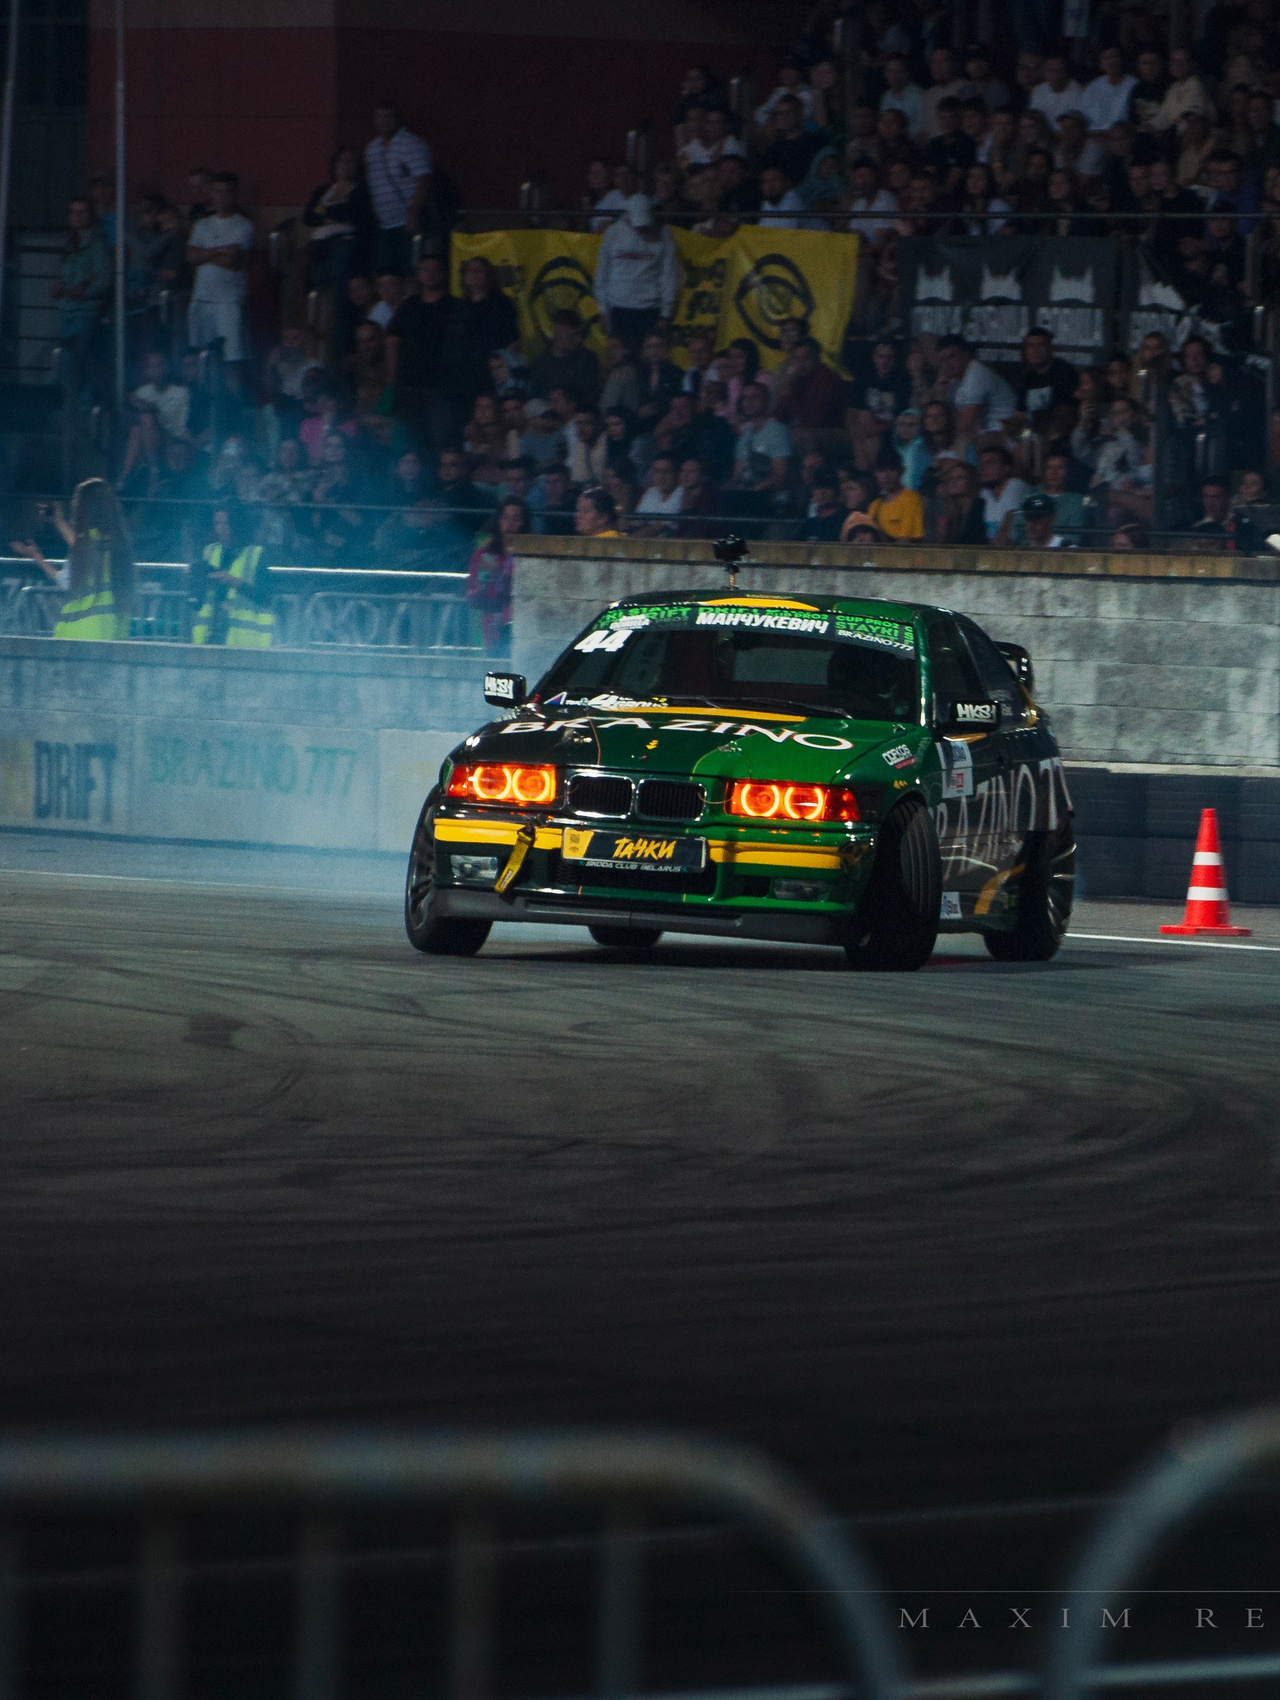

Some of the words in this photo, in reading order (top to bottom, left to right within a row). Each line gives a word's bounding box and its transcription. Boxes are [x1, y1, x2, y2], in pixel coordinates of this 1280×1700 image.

[695, 612, 829, 634] МАНЧУКЕВИЧ
[574, 629, 635, 653] 44
[500, 716, 854, 750] BRAZINO
[34, 739, 117, 822] DRIFT
[612, 837, 677, 861] ТАЧКИ
